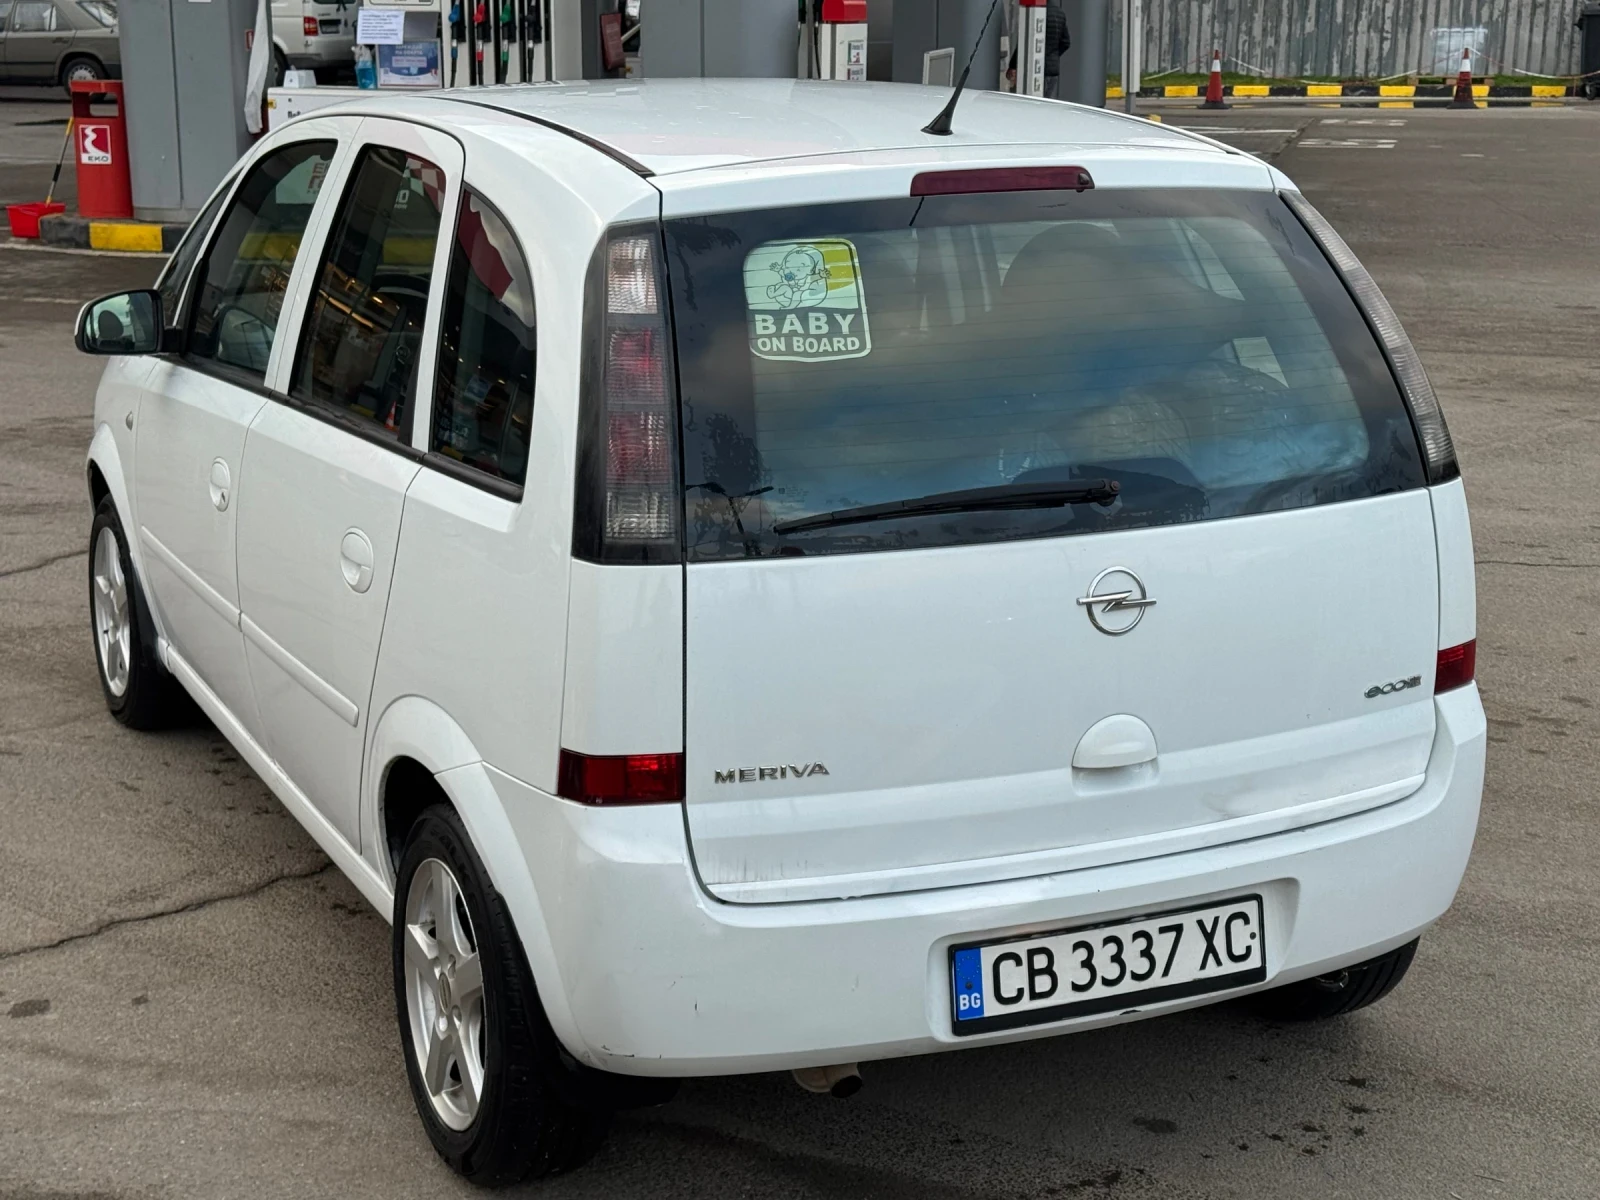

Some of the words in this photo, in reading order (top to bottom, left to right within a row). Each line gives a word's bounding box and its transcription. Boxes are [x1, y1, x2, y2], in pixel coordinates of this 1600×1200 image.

[754, 312, 856, 335] BABY
[757, 337, 787, 352] ON
[792, 336, 860, 353] BOARD
[714, 760, 830, 784] MERIVA
[992, 946, 1058, 1005] CB
[1070, 923, 1184, 992] 3337
[1196, 911, 1252, 971] XC
[959, 993, 982, 1010] BG
